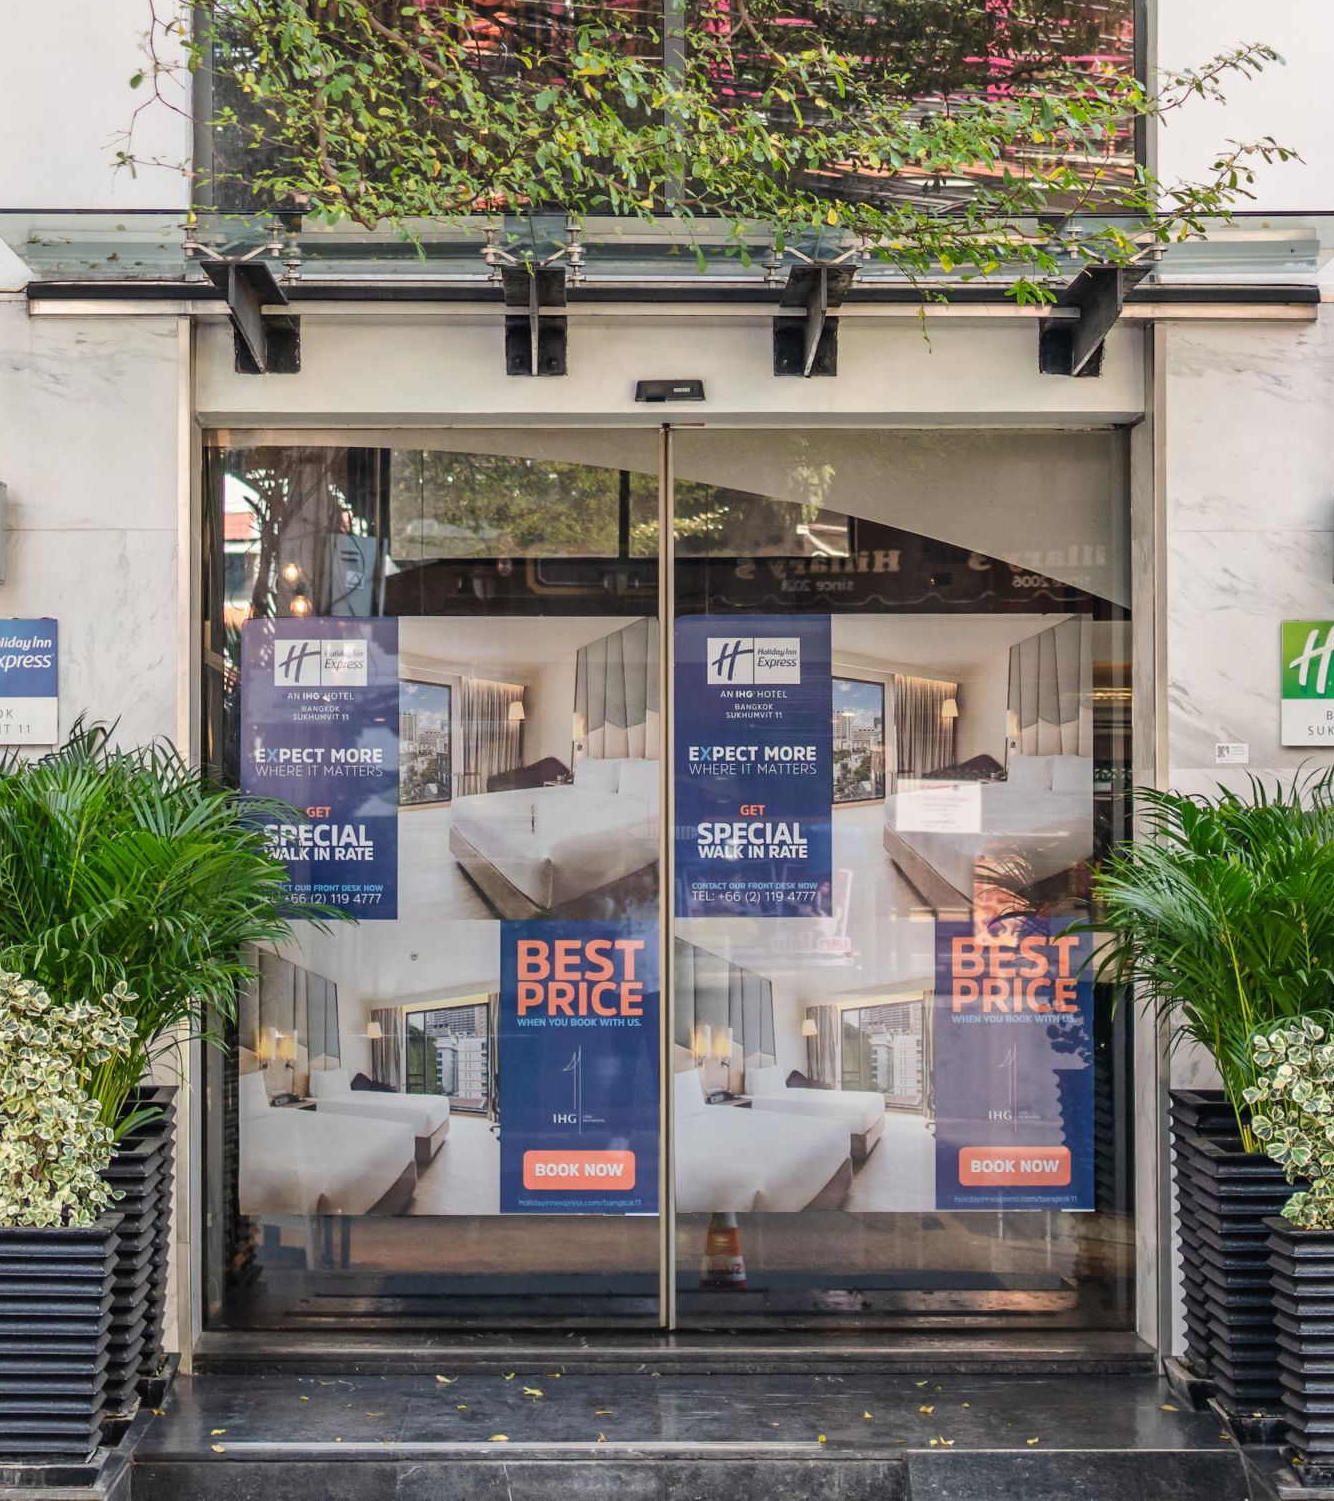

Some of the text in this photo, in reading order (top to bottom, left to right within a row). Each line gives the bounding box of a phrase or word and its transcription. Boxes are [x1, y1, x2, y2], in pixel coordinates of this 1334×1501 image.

[33, 636, 52, 649] Inn
[353, 650, 364, 660] Inn
[758, 648, 797, 656] Holiday Inn
[324, 659, 364, 671] Express
[758, 656, 797, 669] Express
[287, 692, 354, 700] AN IHG HOTEL
[721, 690, 787, 698] AN IHG HOTEL
[18, 725, 31, 734] 11
[255, 748, 383, 763] EXPECT MORE
[689, 746, 817, 761] EXPECT MORE
[255, 766, 383, 777] WHERE IT MATTERS
[689, 764, 817, 775] WHERE IT MATTERS
[306, 807, 331, 818] GET
[740, 804, 765, 816] GET
[263, 824, 373, 847] SPECIAL
[697, 822, 807, 845] SPECIAL
[265, 848, 373, 860] WALK IN RATE
[698, 846, 807, 859] WALK IN RATE
[295, 884, 311, 892] OUR
[313, 884, 339, 892] FRONT
[341, 884, 361, 892] DESK
[364, 884, 383, 892] NOW
[692, 882, 817, 890] CONTACT OUR FRONT DESK NOW
[311, 893, 327, 904] (2)
[331, 893, 349, 904] 119
[353, 893, 381, 904] 4777
[692, 890, 816, 902] TEL: +66 (2) 119 4777
[517, 940, 645, 981] BEST
[951, 936, 1079, 978] BEST
[517, 982, 644, 1016] PRICE
[952, 978, 1078, 1012] PRICE
[517, 1018, 643, 1027] WHEN YOU BOOK WITH US.
[951, 1014, 981, 1023] WHEN
[983, 1014, 1003, 1023] YOU
[1005, 1014, 1032, 1023] BOOK
[1035, 1014, 1059, 1023] WITH
[553, 1113, 577, 1124] IHG
[988, 1110, 1012, 1121] IHG
[535, 1164, 624, 1177] BOOK NOW
[971, 1160, 1059, 1174] BOOK NOW
